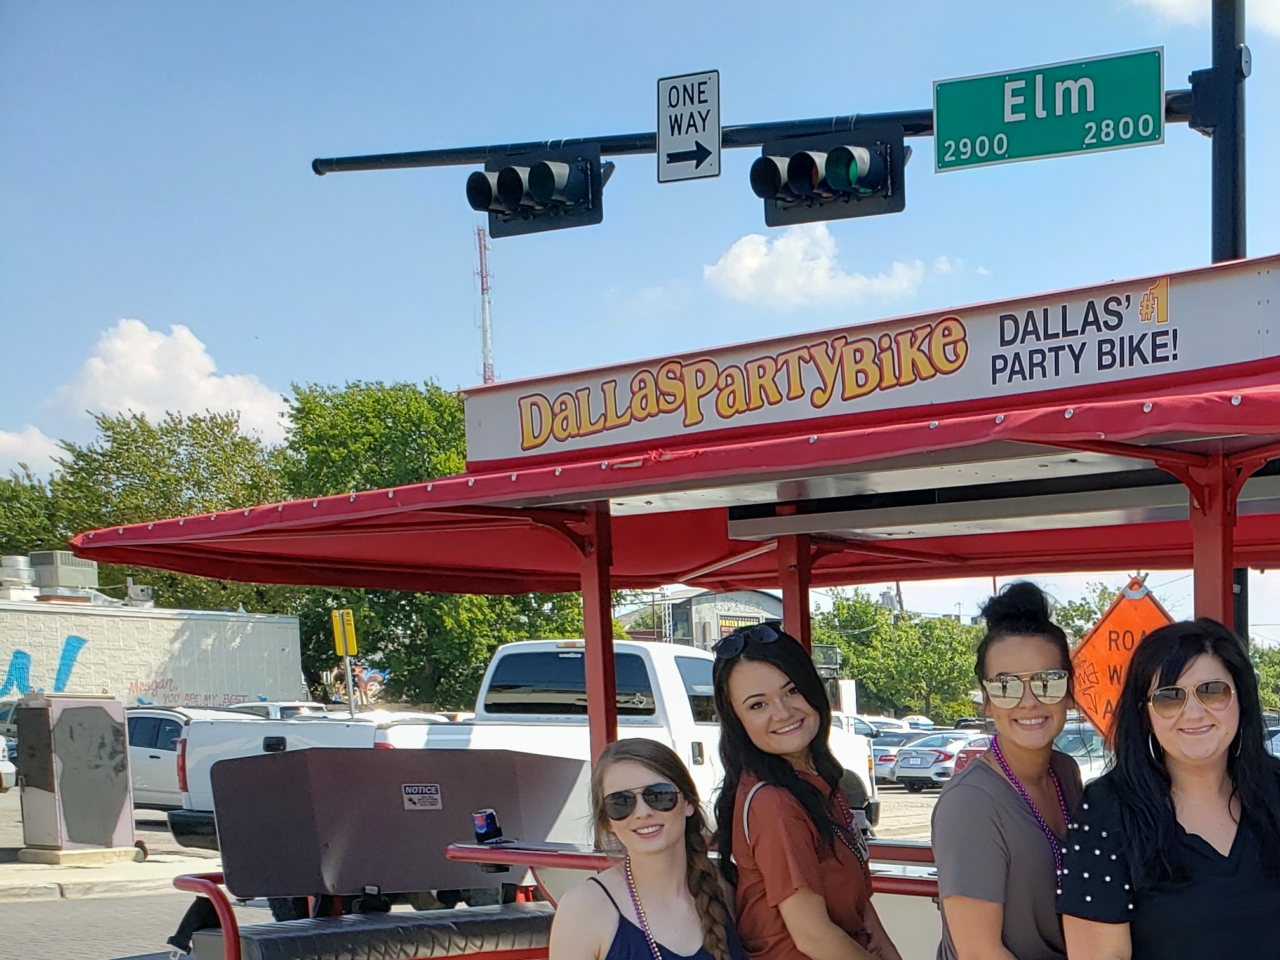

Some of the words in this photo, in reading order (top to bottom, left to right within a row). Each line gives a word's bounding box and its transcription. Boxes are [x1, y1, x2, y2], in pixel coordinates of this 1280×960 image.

[668, 80, 709, 109] ONE
[1004, 73, 1095, 123] Elm
[669, 108, 711, 137] WAY
[944, 133, 1008, 162] 2900
[1084, 113, 1154, 145] 2800
[1000, 294, 1131, 347] DALLAS'
[1140, 276, 1170, 323] #1
[991, 341, 1087, 385] PARTY
[1097, 328, 1178, 371] BIKE!
[163, 693, 180, 704] YOU
[184, 693, 201, 703] ARE
[204, 694, 218, 703] MY
[223, 694, 249, 704] BEST
[405, 786, 438, 794] NOTICE
